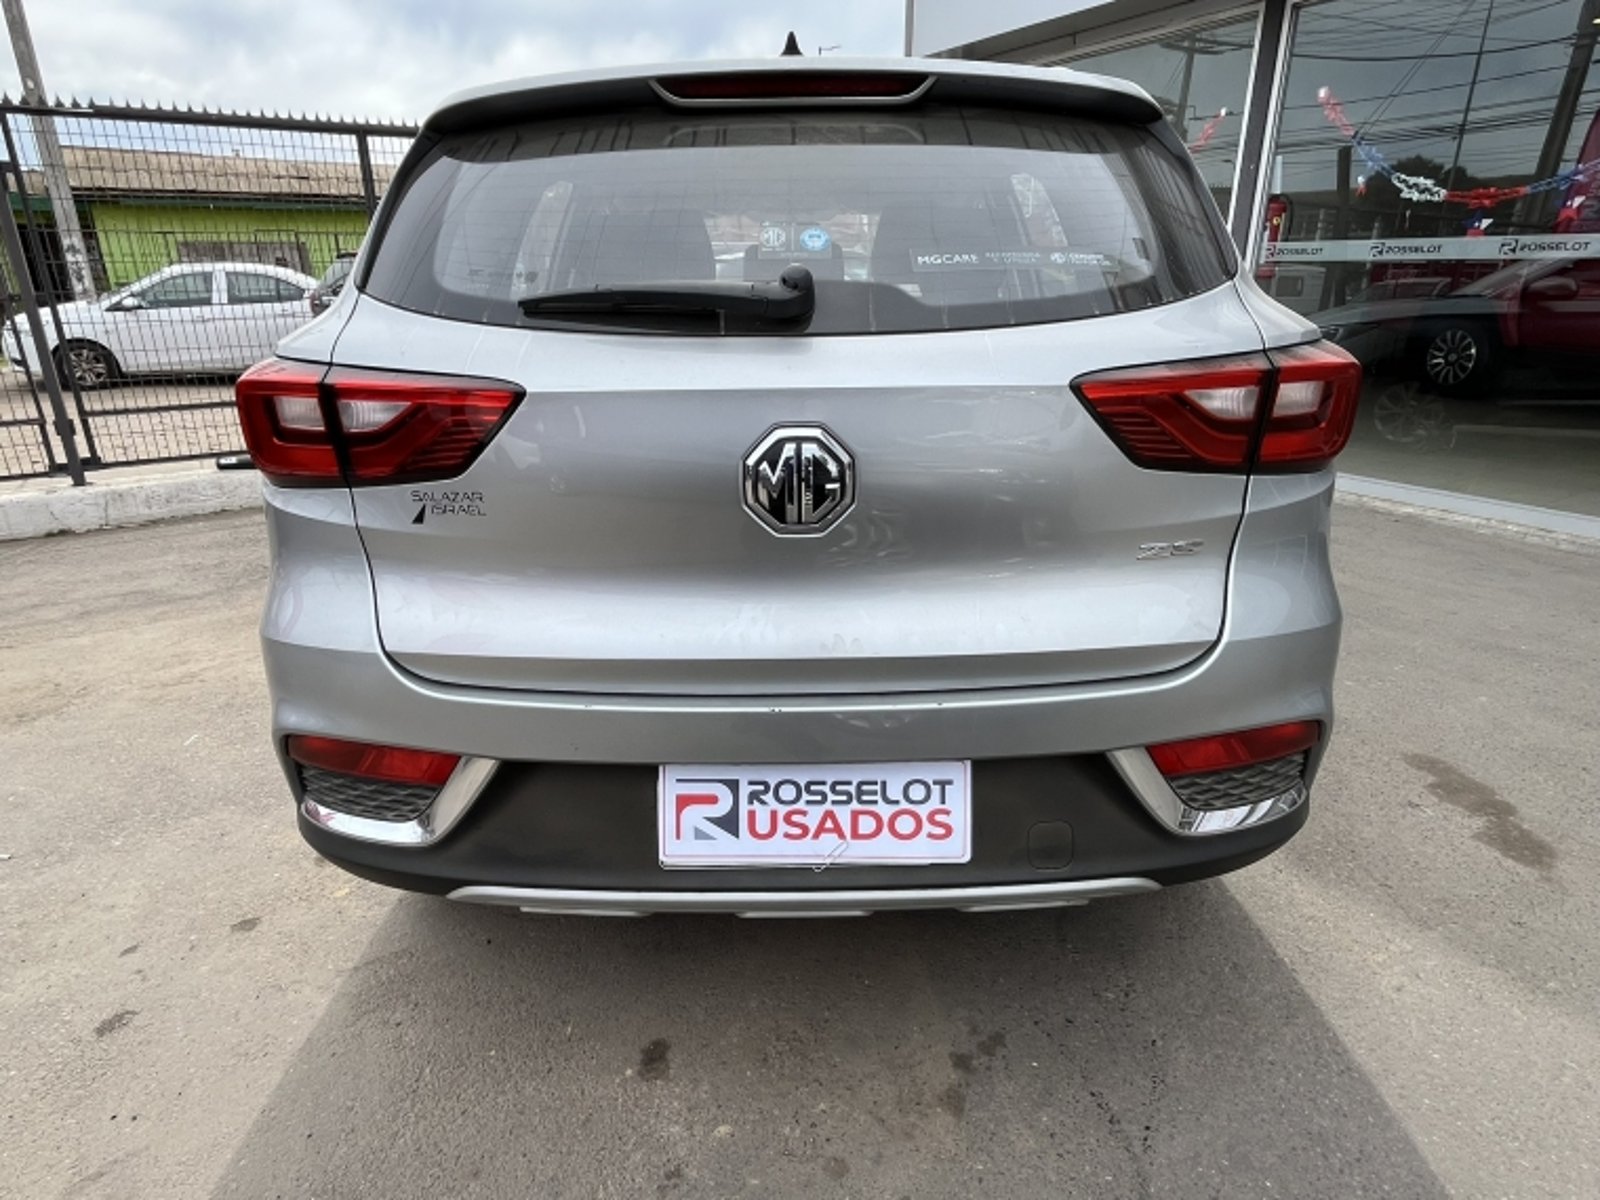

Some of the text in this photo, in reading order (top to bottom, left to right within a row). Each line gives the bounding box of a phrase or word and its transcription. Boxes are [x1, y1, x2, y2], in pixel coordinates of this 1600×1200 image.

[1385, 245, 1443, 254] ROSSELOT
[1519, 242, 1591, 252] ROSSELOT
[756, 440, 842, 525] MG
[410, 490, 485, 503] SALAZAR
[431, 504, 487, 517] ISRAEL
[747, 778, 954, 806] ROSSELOT
[747, 808, 954, 840] USADOS
